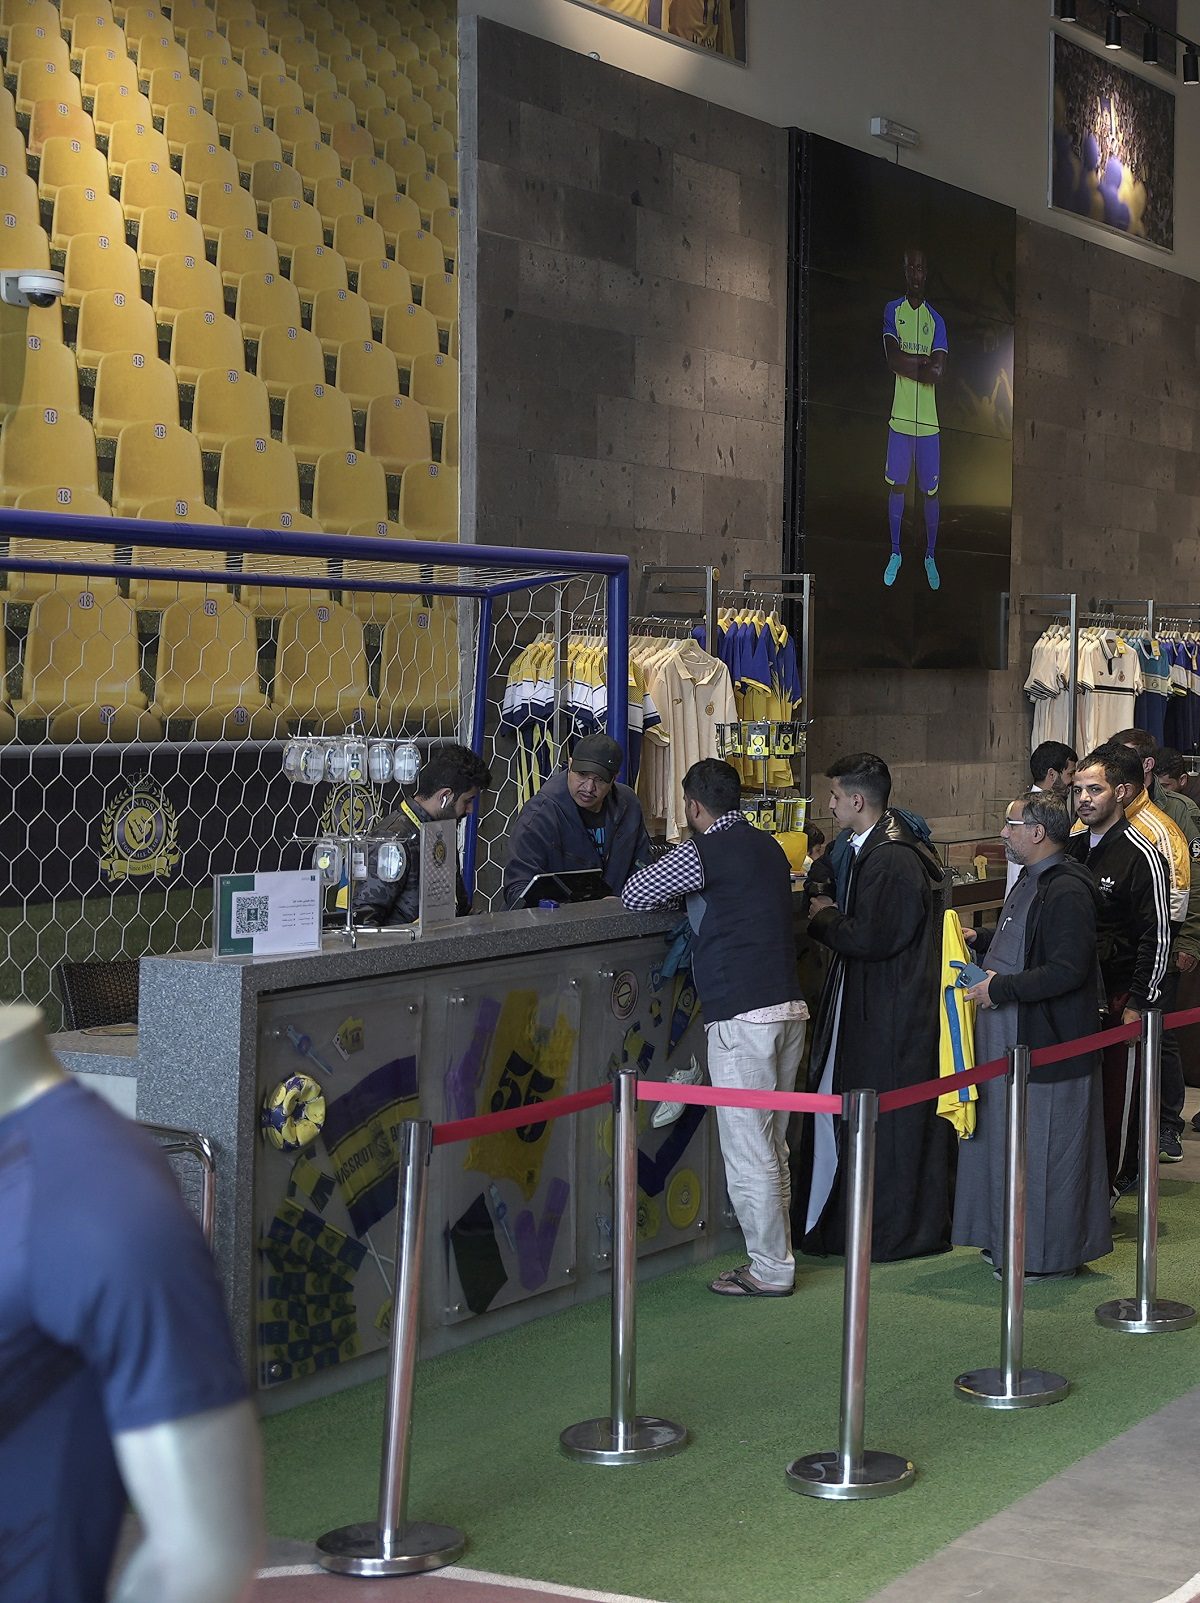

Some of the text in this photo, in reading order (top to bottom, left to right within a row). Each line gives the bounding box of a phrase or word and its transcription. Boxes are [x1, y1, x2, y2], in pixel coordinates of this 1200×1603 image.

[6, 215, 14, 226] 18
[205, 313, 214, 324] 20
[30, 337, 39, 348] 18
[134, 355, 143, 366] 19
[229, 371, 237, 382] 20
[45, 410, 55, 422] 18
[156, 425, 164, 436] 19
[256, 440, 265, 452] 20
[59, 490, 69, 502] 18
[177, 502, 186, 514] 19
[281, 514, 291, 526] 20
[378, 523, 386, 535] 21
[81, 594, 91, 608] 18
[206, 601, 216, 614] 19
[317, 608, 328, 621] 20
[417, 614, 428, 628] 21
[235, 709, 246, 722] 19
